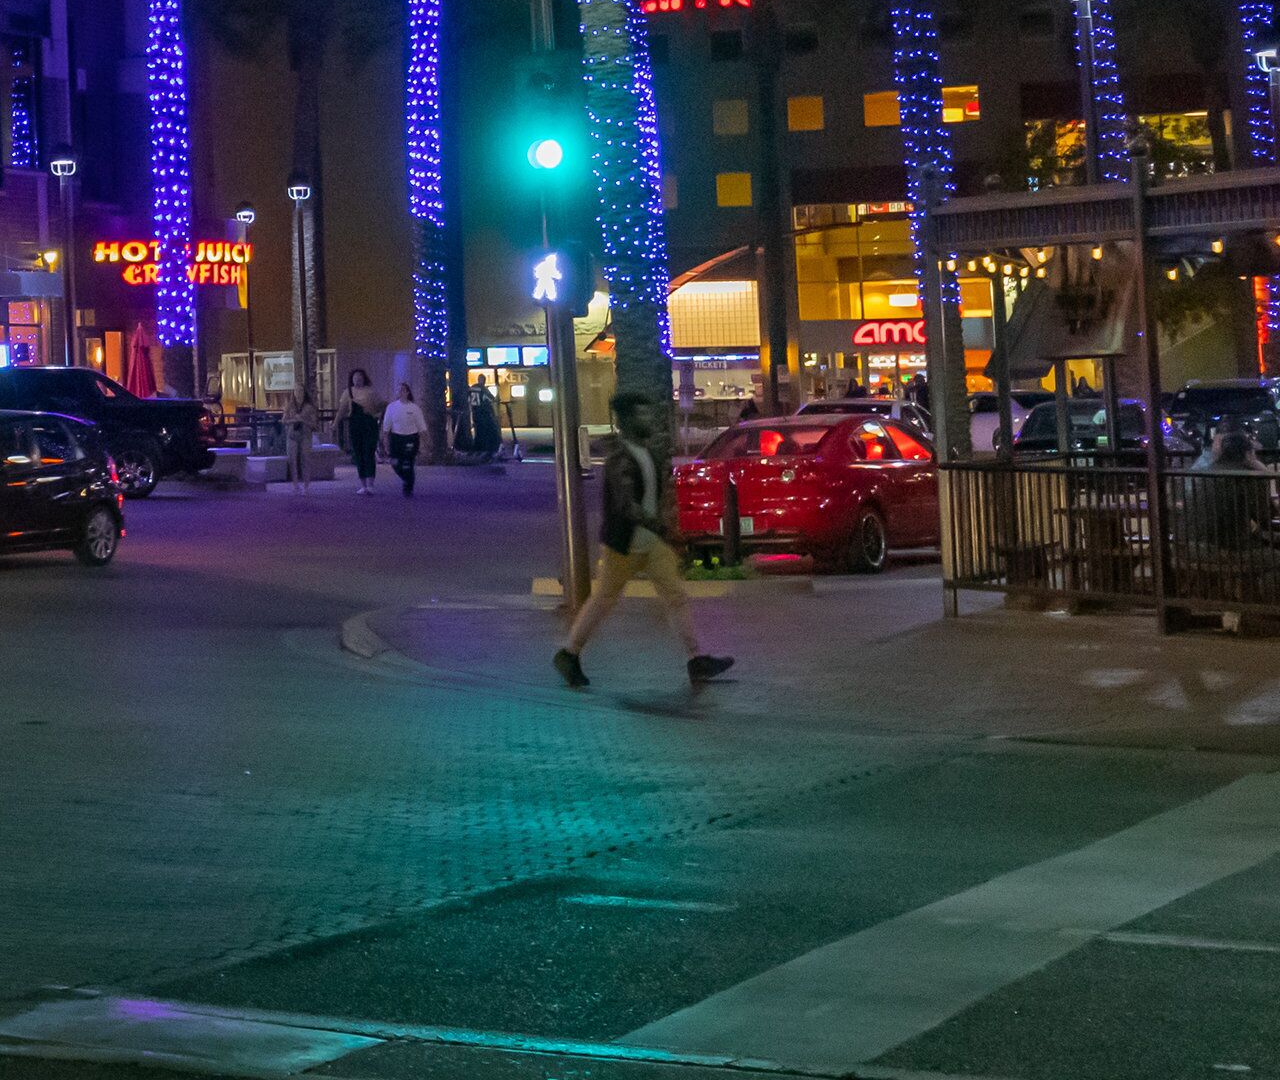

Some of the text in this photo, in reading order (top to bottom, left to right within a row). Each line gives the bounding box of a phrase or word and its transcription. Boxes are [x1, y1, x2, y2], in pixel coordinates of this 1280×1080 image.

[94, 240, 161, 263] HOT
[195, 242, 253, 264] JUICY
[694, 360, 727, 369] TICKETS
